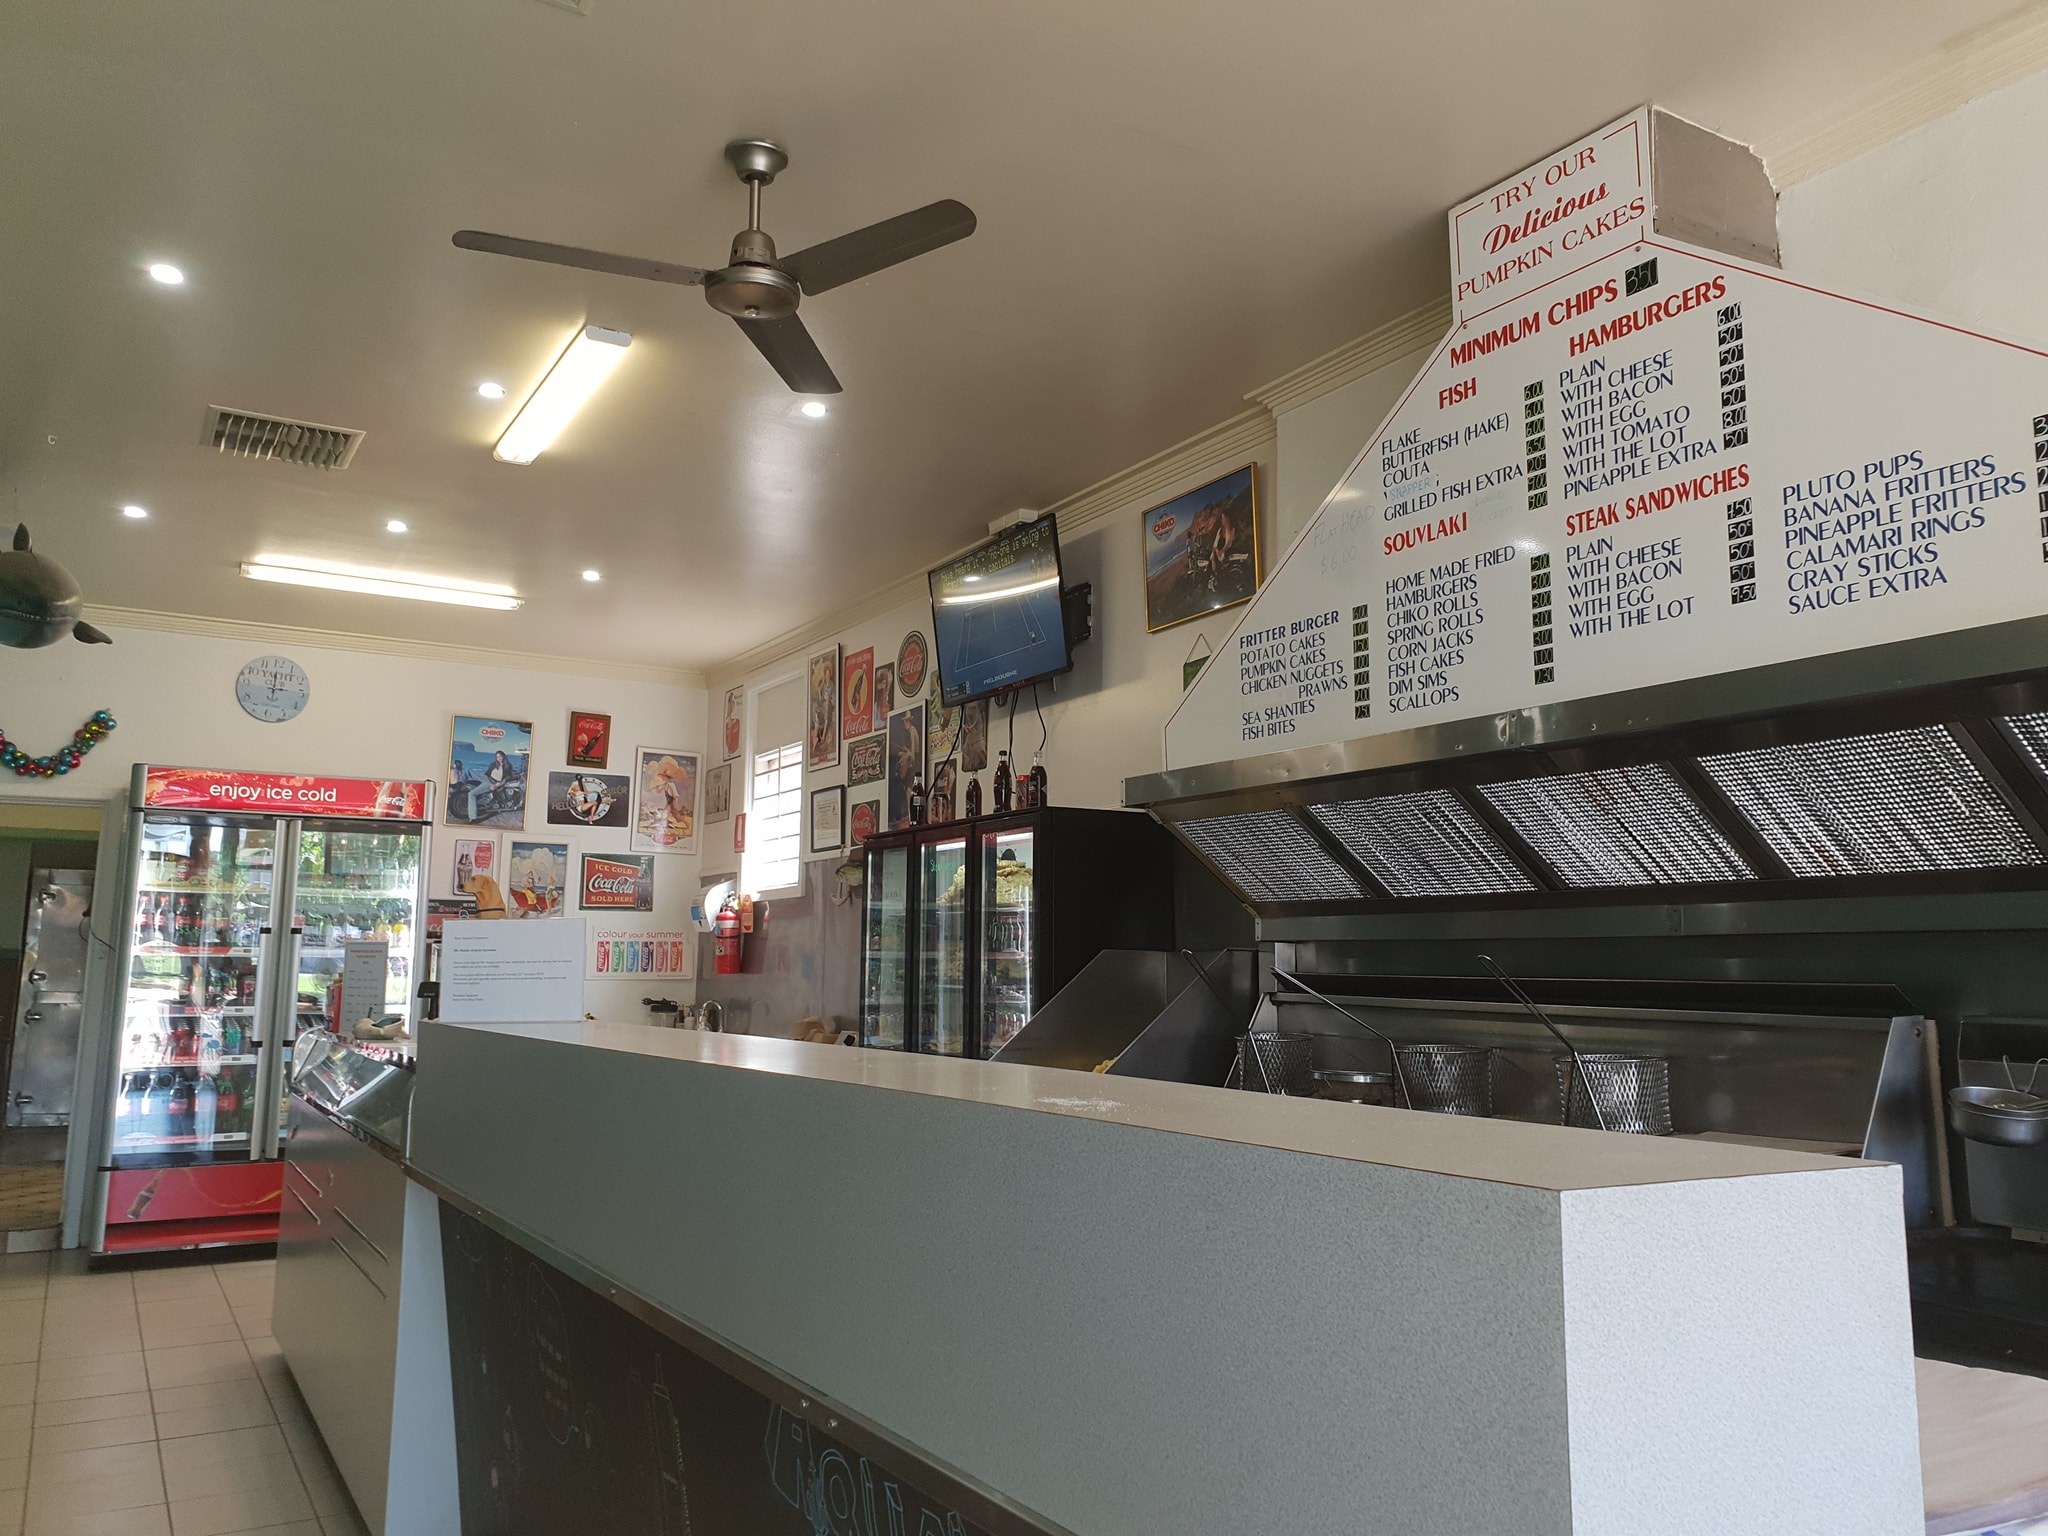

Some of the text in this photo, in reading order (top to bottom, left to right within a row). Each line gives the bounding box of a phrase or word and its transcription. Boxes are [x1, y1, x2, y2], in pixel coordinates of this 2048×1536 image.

[1491, 147, 1596, 214] TRY OUR
[1483, 182, 1610, 255] Delicious
[1457, 197, 1645, 302] PUMPKIN CAKES
[1625, 258, 1658, 297] 3.50
[1451, 279, 1618, 369] MINIMUM CHIPS
[1569, 275, 1726, 357] HAMBURGERS
[1718, 302, 1742, 326] 6.00
[1559, 356, 1606, 388] PLAIN
[1560, 349, 1674, 404] WITH CHEESE
[1438, 377, 1477, 410] FISH
[1561, 370, 1674, 423] WITH BACON
[1562, 400, 1646, 442] WITH EGG
[1562, 405, 1691, 460] WITH TOMATO
[1382, 428, 1421, 455] FLAKE
[1383, 413, 1509, 472] BUTTERFISH (HAKE)
[1563, 425, 1687, 479] WITH THE LOT
[1383, 461, 1430, 488] COUTA
[1564, 438, 1717, 500] PINEAPPLE EXTRA
[1782, 450, 1924, 506] PLUTO PUPS
[1384, 492, 1437, 521] GRILLED
[1442, 479, 1471, 503] FISH
[1476, 463, 1523, 491] EXTRA
[1389, 478, 1431, 501] SNAPPER
[1566, 463, 1750, 537] STEAK SANDWICHES
[1783, 488, 1876, 527] BANANA
[1884, 454, 1997, 501] FRITTERS
[1153, 517, 1176, 534] CHIKO
[1784, 502, 1903, 549] PINEAPPLE
[1911, 471, 2027, 518] FRITTERS
[1384, 511, 1468, 556] SOUVLAKI
[1566, 535, 1613, 563] PLAIN
[1786, 506, 1986, 570] CALAMARI RINGS
[1386, 545, 1516, 595] HOME MADE FRIED
[1567, 537, 1682, 581] WITH CHEESE
[1787, 542, 1939, 593] CRAY STICKS
[1386, 574, 1478, 611] HAMBURGERS
[1568, 557, 1683, 600] WITH BACON
[1731, 583, 1756, 604] 9.50
[1788, 565, 1948, 615] SAUCE EXTRA
[1387, 605, 1429, 628] CHIKO
[1433, 591, 1479, 617] ROLLS
[1568, 586, 1655, 619] WITH EGG
[1569, 596, 1695, 639] WITH THE LOT
[1240, 626, 1286, 649] FRITTER
[1290, 610, 1339, 635] BURGER
[1387, 608, 1484, 645] SPRING ROLLS
[1240, 632, 1326, 665] POTATO CAKES
[1388, 629, 1474, 662] CORN JACKS
[983, 669, 1019, 686] MELBOURNE
[1240, 648, 1326, 681] PUMPKIN CAKES
[1241, 660, 1344, 696] CHICKEN NUGGETS
[1388, 649, 1464, 680] FISH CAKES
[1298, 675, 1348, 699] PRAWNS
[1388, 670, 1448, 697] DIM SIMS
[1389, 686, 1460, 713] SCALLOPS
[1242, 699, 1315, 726] SEA SHANTIES
[1242, 719, 1296, 741] FISH BITES
[481, 728, 505, 738] CHIKO
[209, 783, 337, 803] enjoy ice cold
[551, 796, 580, 813] HELLO
[595, 863, 633, 875] ICE COLD
[598, 930, 684, 939] colour your summer
